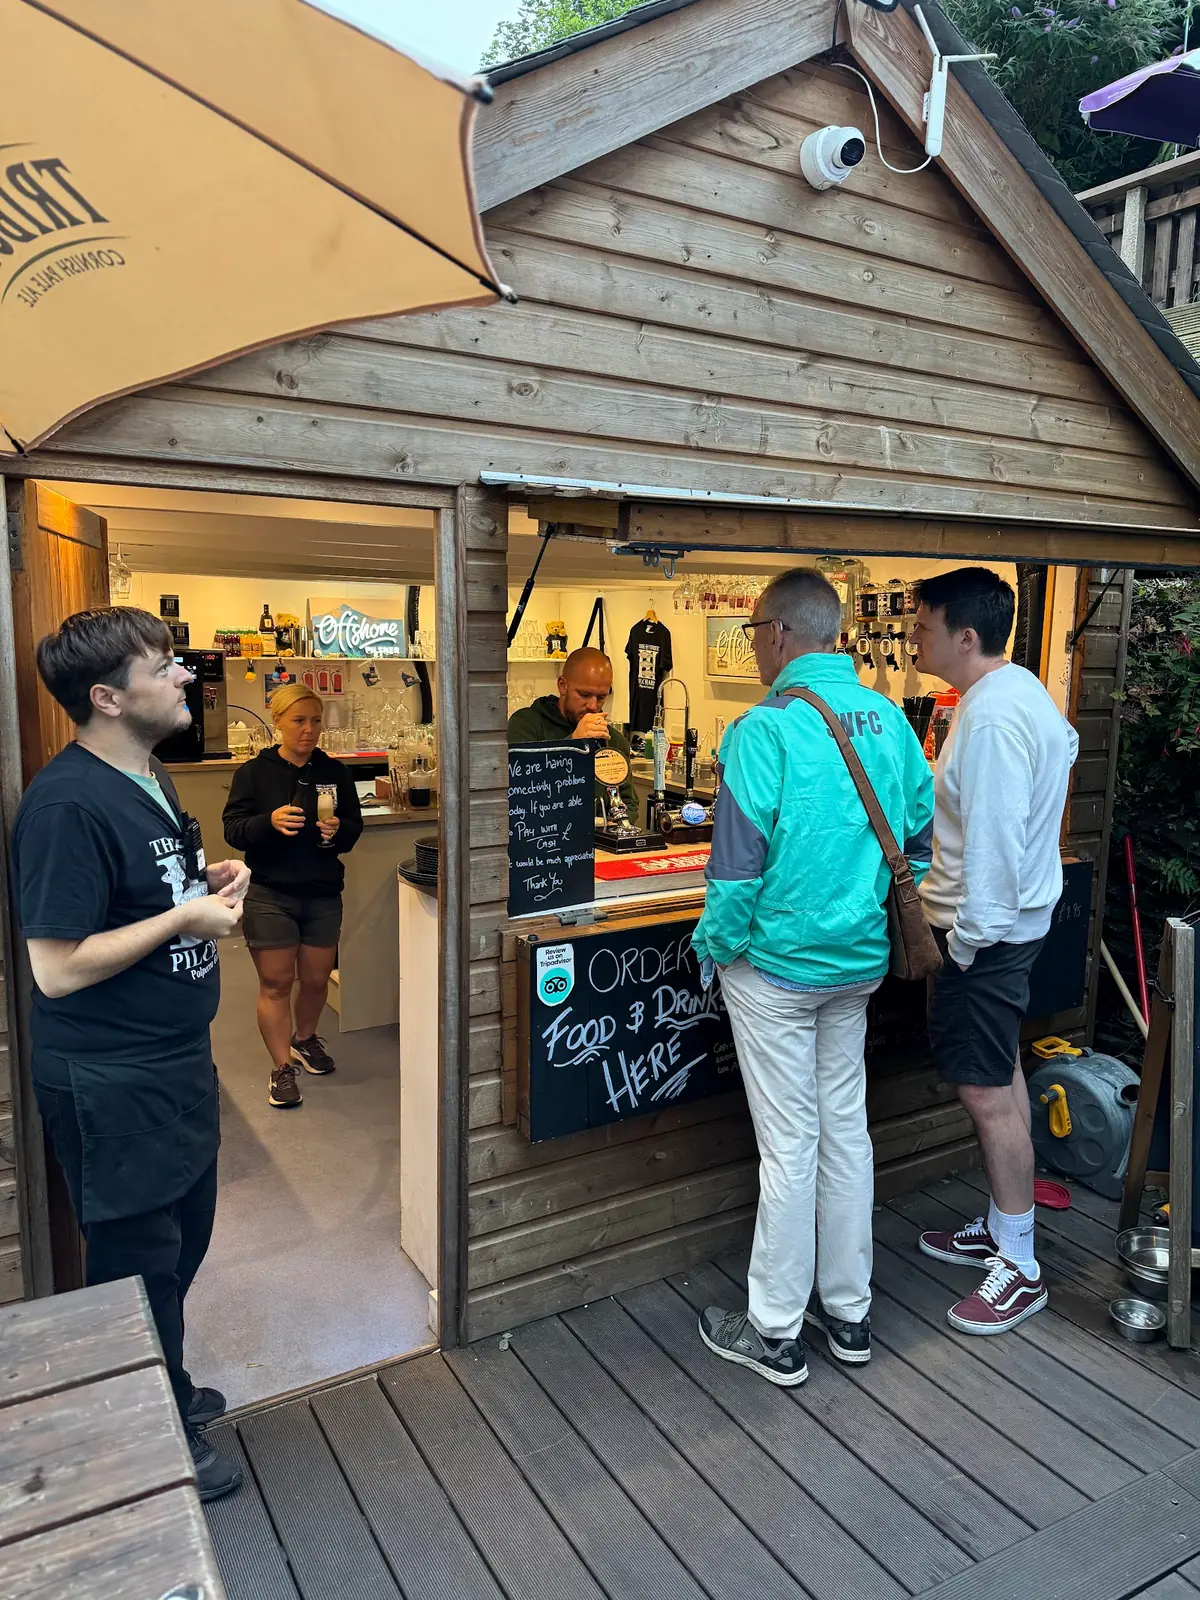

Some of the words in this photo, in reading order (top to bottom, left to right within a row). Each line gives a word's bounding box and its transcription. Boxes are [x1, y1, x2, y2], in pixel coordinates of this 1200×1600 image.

[315, 611, 399, 652] Offshore
[826, 710, 883, 738] WFC
[525, 763, 543, 775] are
[545, 753, 573, 773] having
[508, 805, 528, 820] oday.
[530, 799, 538, 814] If
[539, 804, 551, 818] you
[552, 802, 564, 810] are
[567, 795, 583, 807] able
[514, 821, 535, 840] PAY
[561, 822, 573, 841] £
[536, 838, 557, 850] CASH
[515, 857, 534, 868] would
[535, 856, 545, 867] be
[546, 855, 562, 865] much
[522, 874, 548, 892] Thank
[548, 871, 563, 890] You
[539, 957, 572, 968] Tripadvisor
[545, 947, 567, 956] Review
[588, 932, 693, 993] ORDER
[541, 1006, 617, 1062] FOOD
[601, 1030, 682, 1113] HERE
